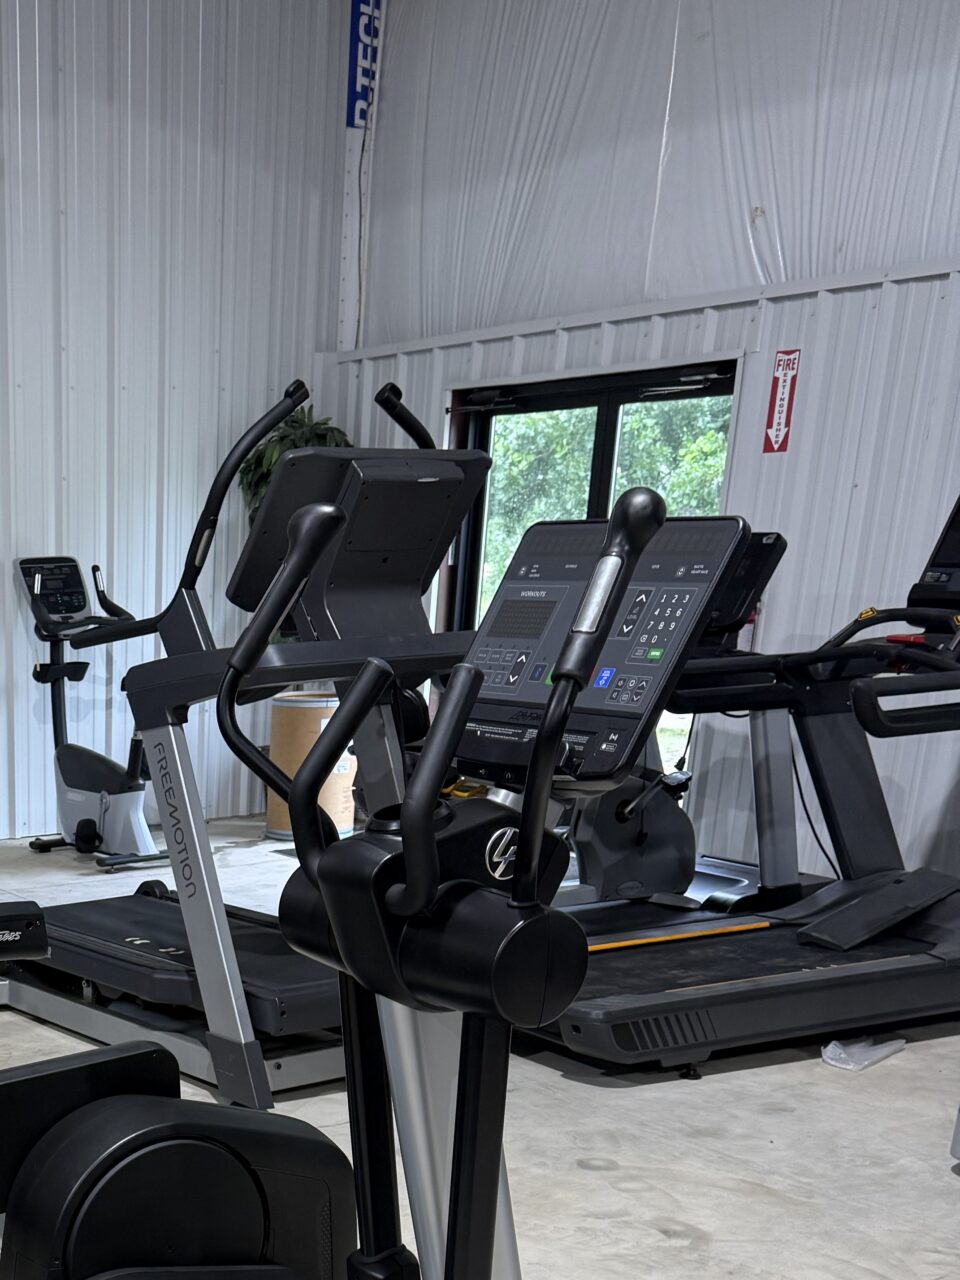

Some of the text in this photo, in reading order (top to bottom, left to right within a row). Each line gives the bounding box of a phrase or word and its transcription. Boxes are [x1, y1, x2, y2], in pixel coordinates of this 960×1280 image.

[776, 358, 797, 372] FIRE
[774, 372, 788, 445] EXTINGUISHER
[660, 594, 690, 603] 1 2 3
[653, 608, 683, 617] 4 5 6
[647, 621, 676, 631] 7 8 9
[153, 742, 197, 899] FREEMOTION
